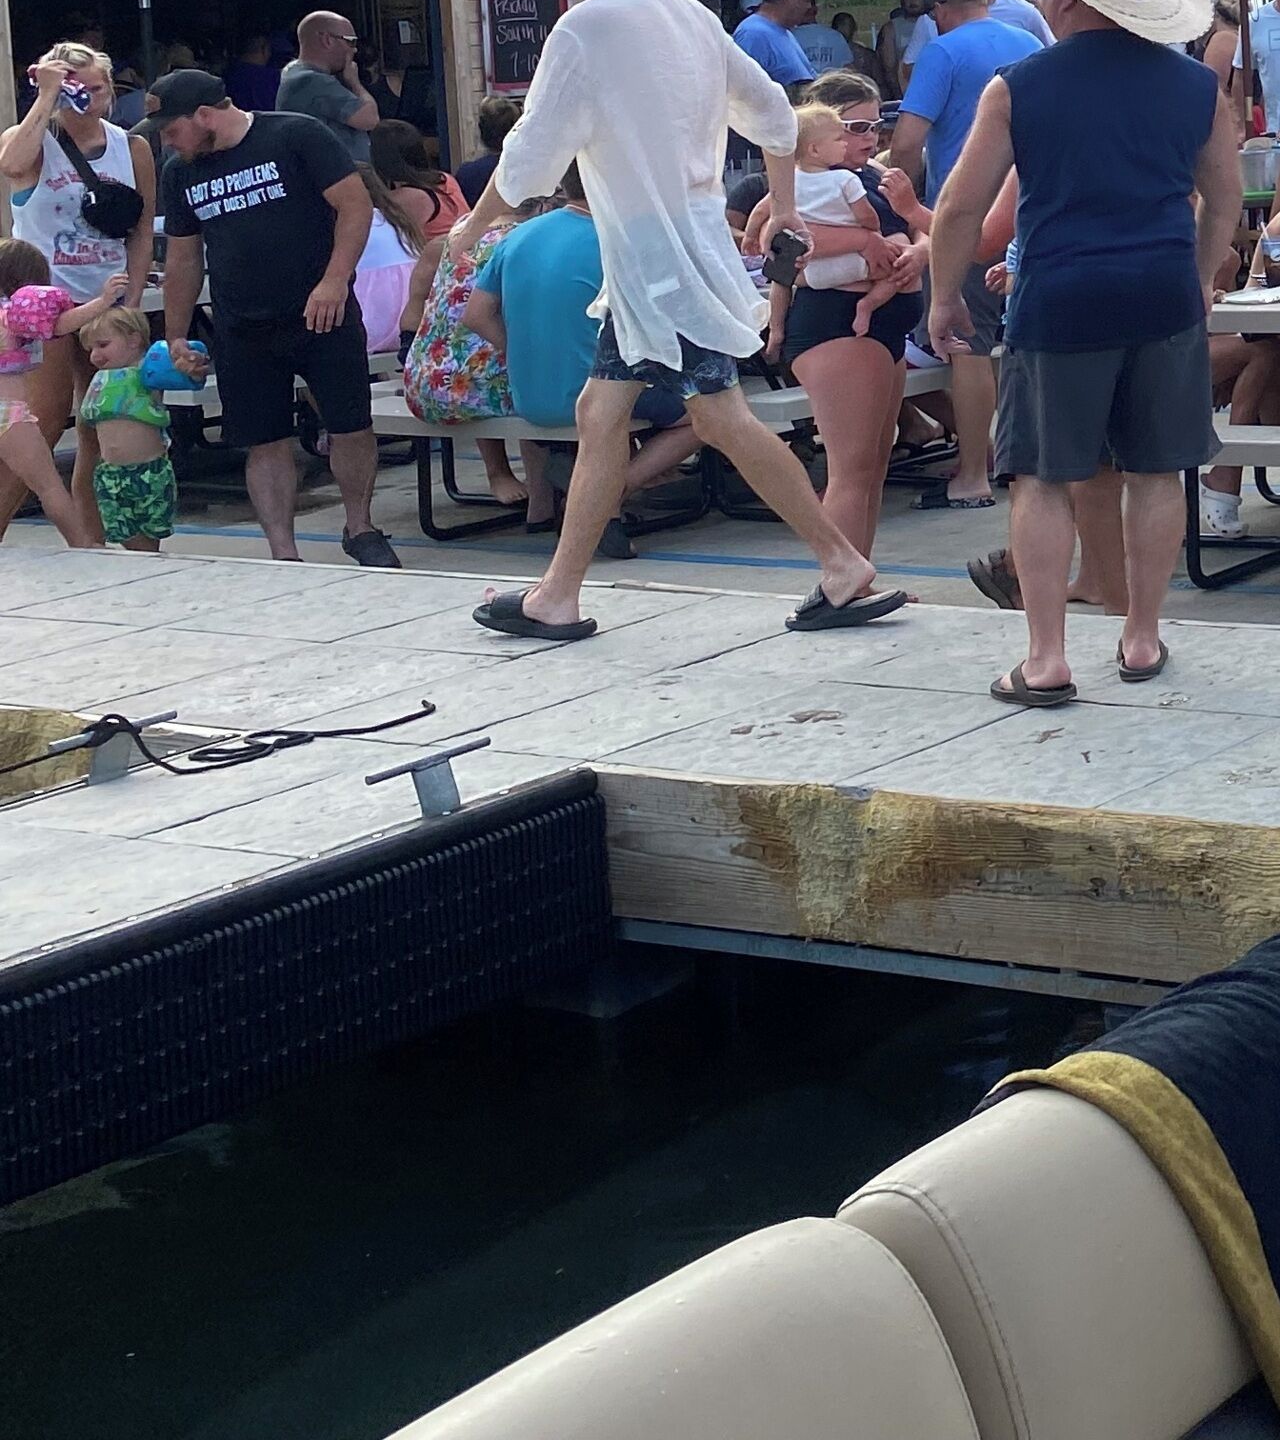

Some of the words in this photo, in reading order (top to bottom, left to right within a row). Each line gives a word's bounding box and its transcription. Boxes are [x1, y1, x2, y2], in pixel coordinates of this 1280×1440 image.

[496, 25, 535, 45] South
[185, 188, 193, 206] I
[191, 182, 208, 204] GOT
[211, 178, 224, 197] 99
[225, 161, 279, 193] PROBLEMS
[223, 194, 246, 212] DOES
[267, 183, 287, 200] ONE
